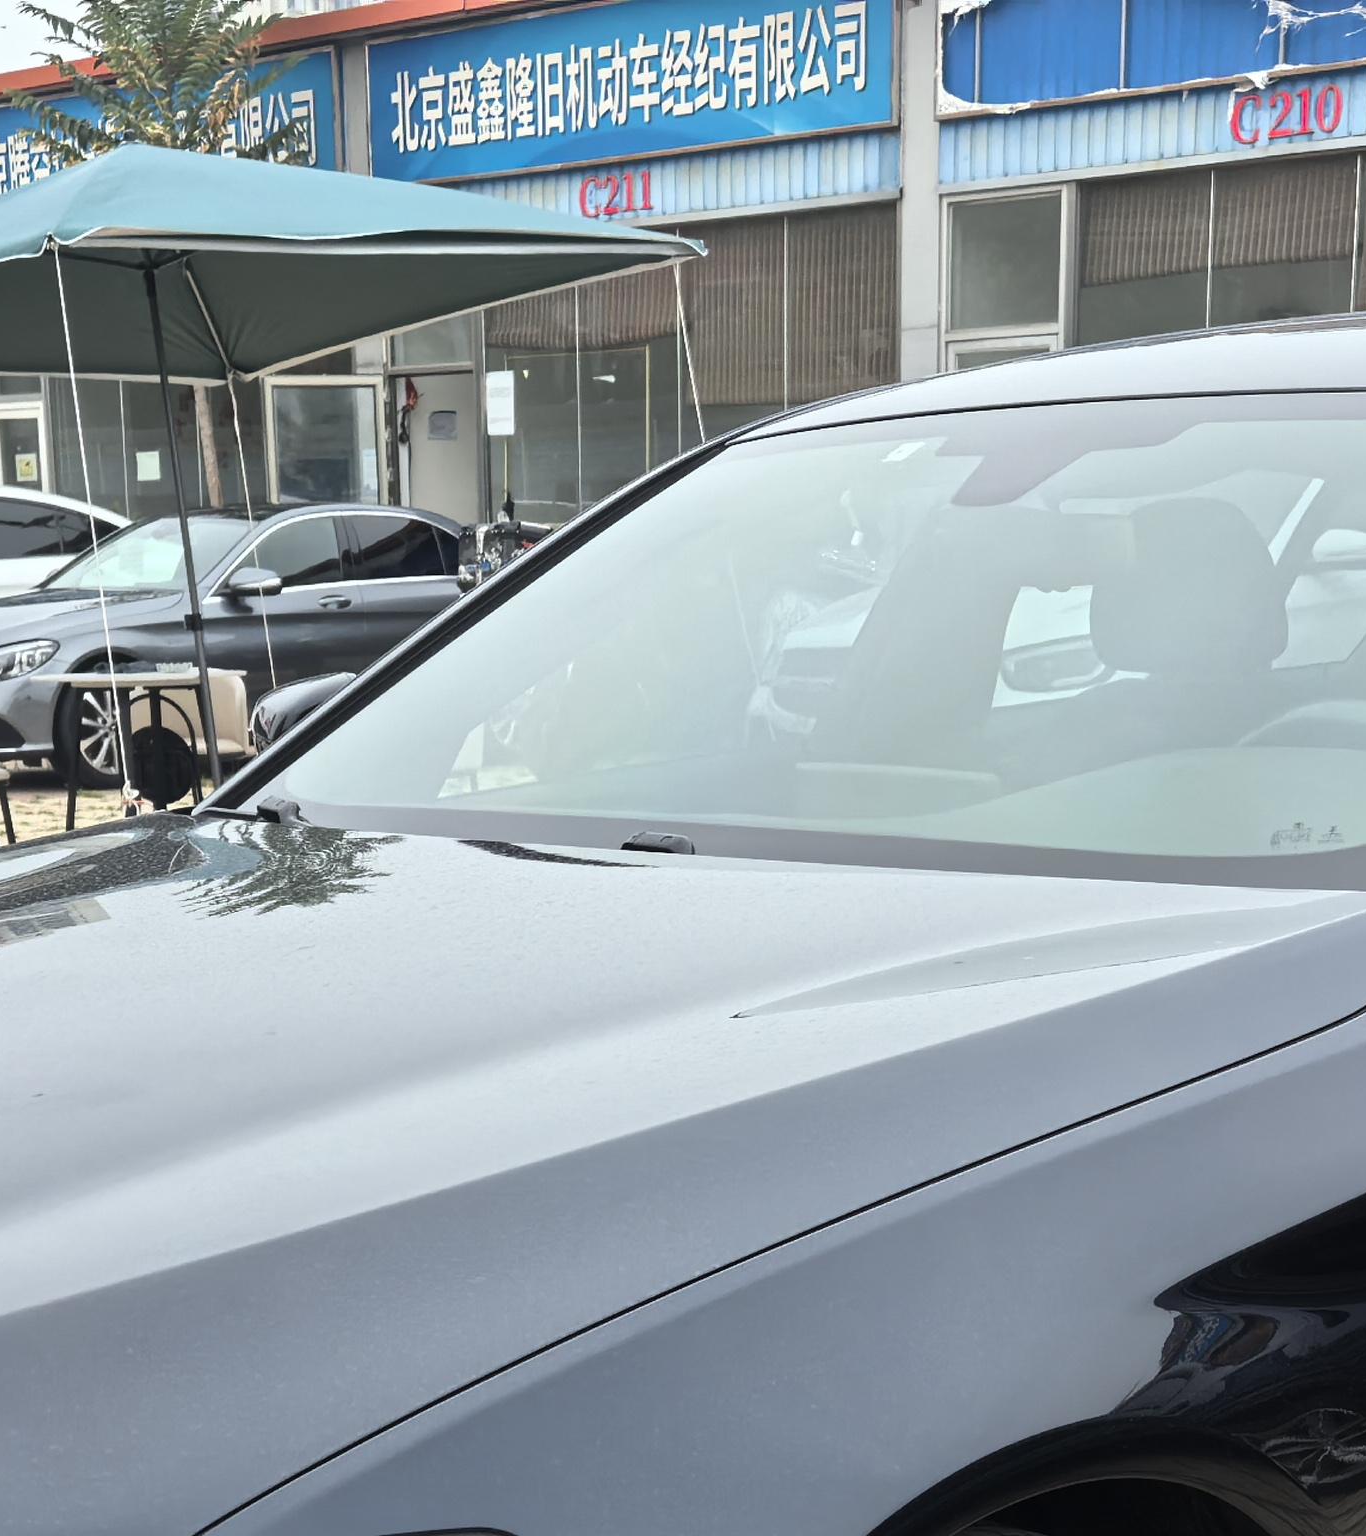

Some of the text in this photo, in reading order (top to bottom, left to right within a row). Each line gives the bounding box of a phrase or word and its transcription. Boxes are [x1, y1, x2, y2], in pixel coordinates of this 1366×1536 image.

[390, 1, 868, 154] 北京盛鑫隆旧机动车经纪有限公司
[1230, 86, 1343, 145] C210
[579, 170, 655, 219] C211
